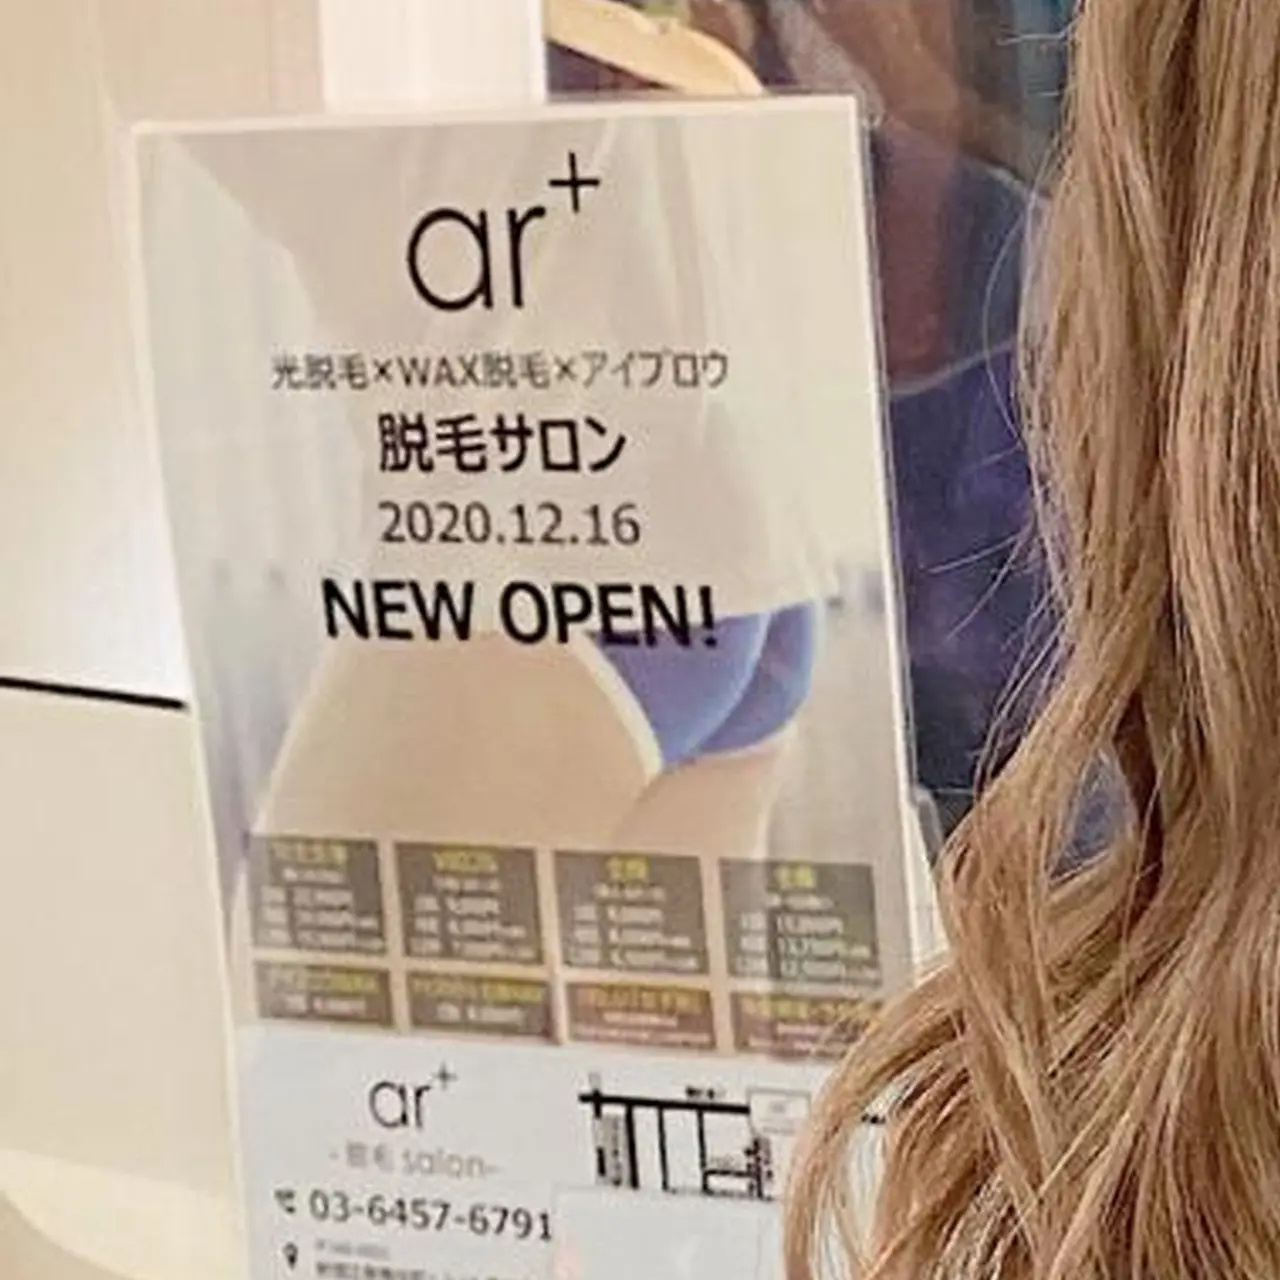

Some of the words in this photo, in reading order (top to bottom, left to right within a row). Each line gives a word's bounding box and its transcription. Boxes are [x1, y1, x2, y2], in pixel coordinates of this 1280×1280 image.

[377, 411, 627, 475] 脱毛サロン
[377, 500, 642, 547] 2020.12.16
[321, 577, 475, 643] NEW
[499, 581, 720, 650] OPEN!
[308, 1189, 553, 1242] 03-6457-6791
